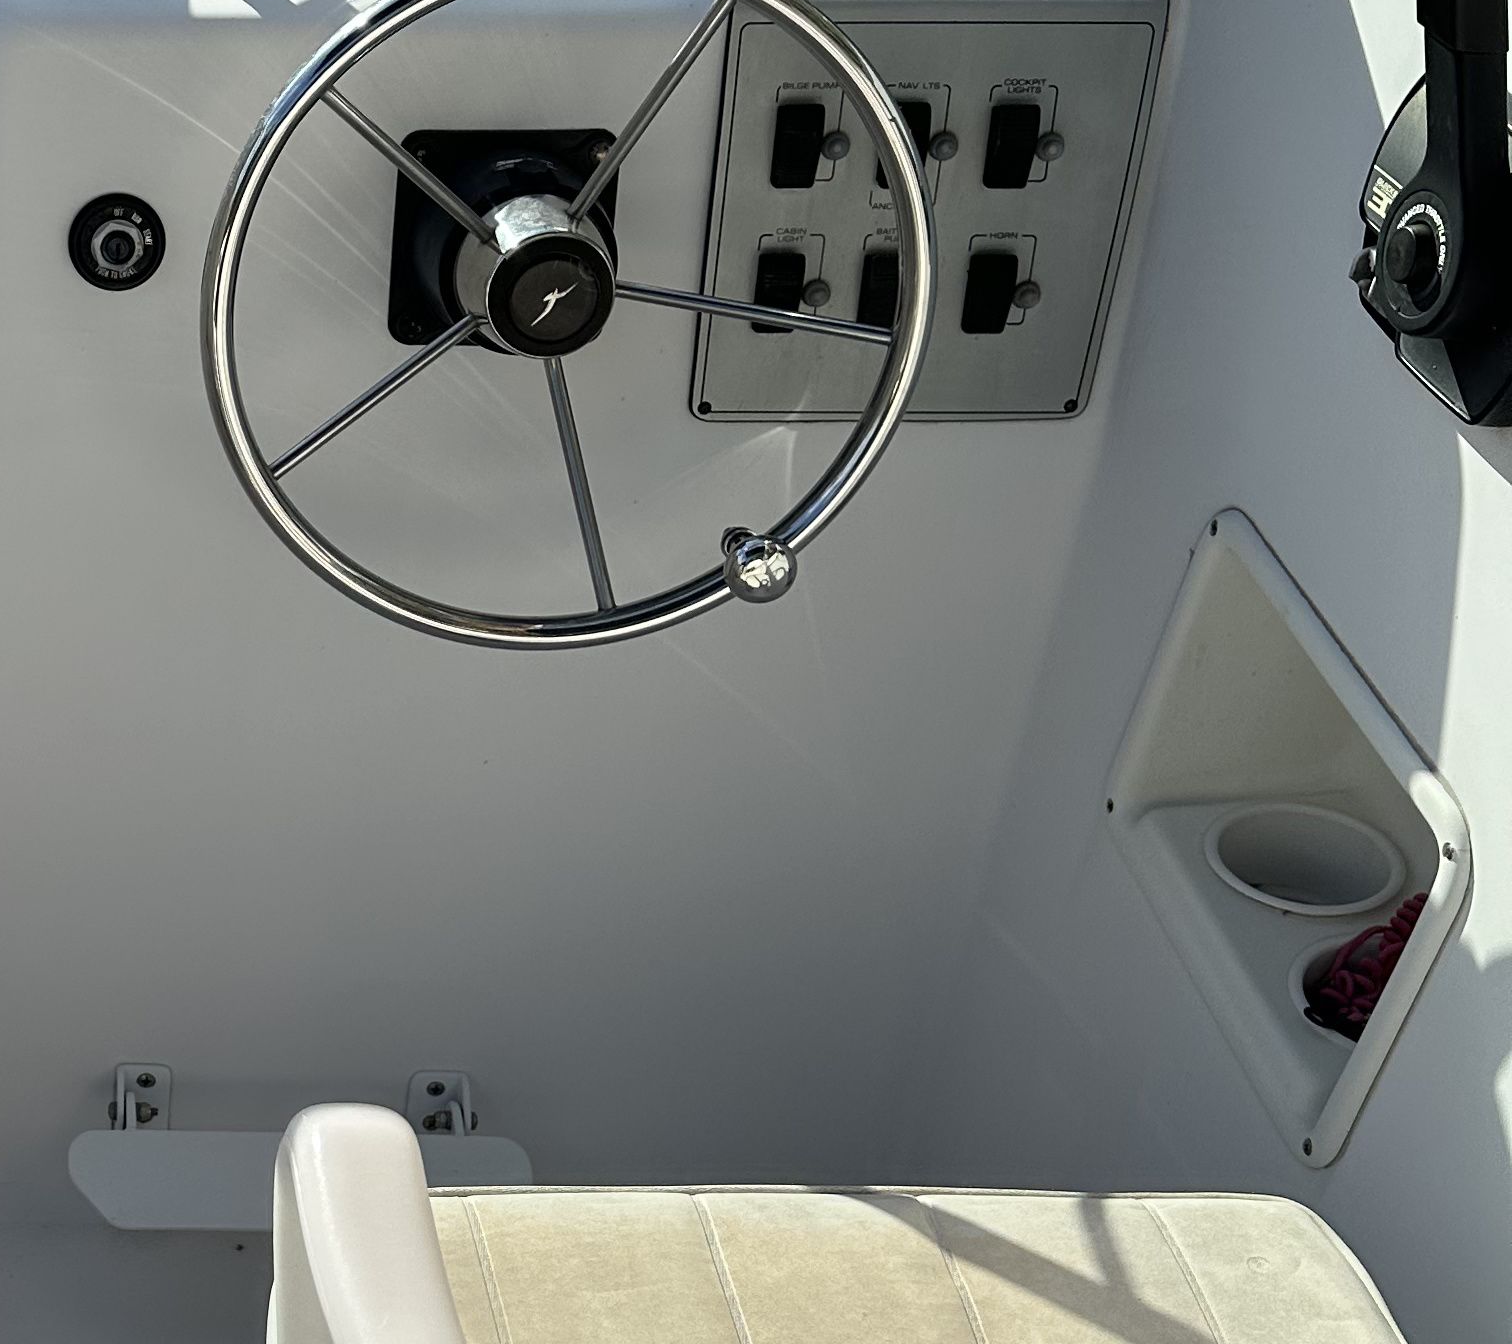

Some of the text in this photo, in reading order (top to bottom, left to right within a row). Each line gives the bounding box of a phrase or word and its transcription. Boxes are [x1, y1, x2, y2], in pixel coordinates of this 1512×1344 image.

[782, 81, 809, 89] BILGE
[898, 81, 941, 90] NAV LTS
[1003, 78, 1047, 86] COCKPIT
[1007, 86, 1043, 94] LIGHTS
[776, 227, 808, 235] CABIN
[777, 235, 804, 243] LIGHT
[989, 231, 1018, 240] HORN
